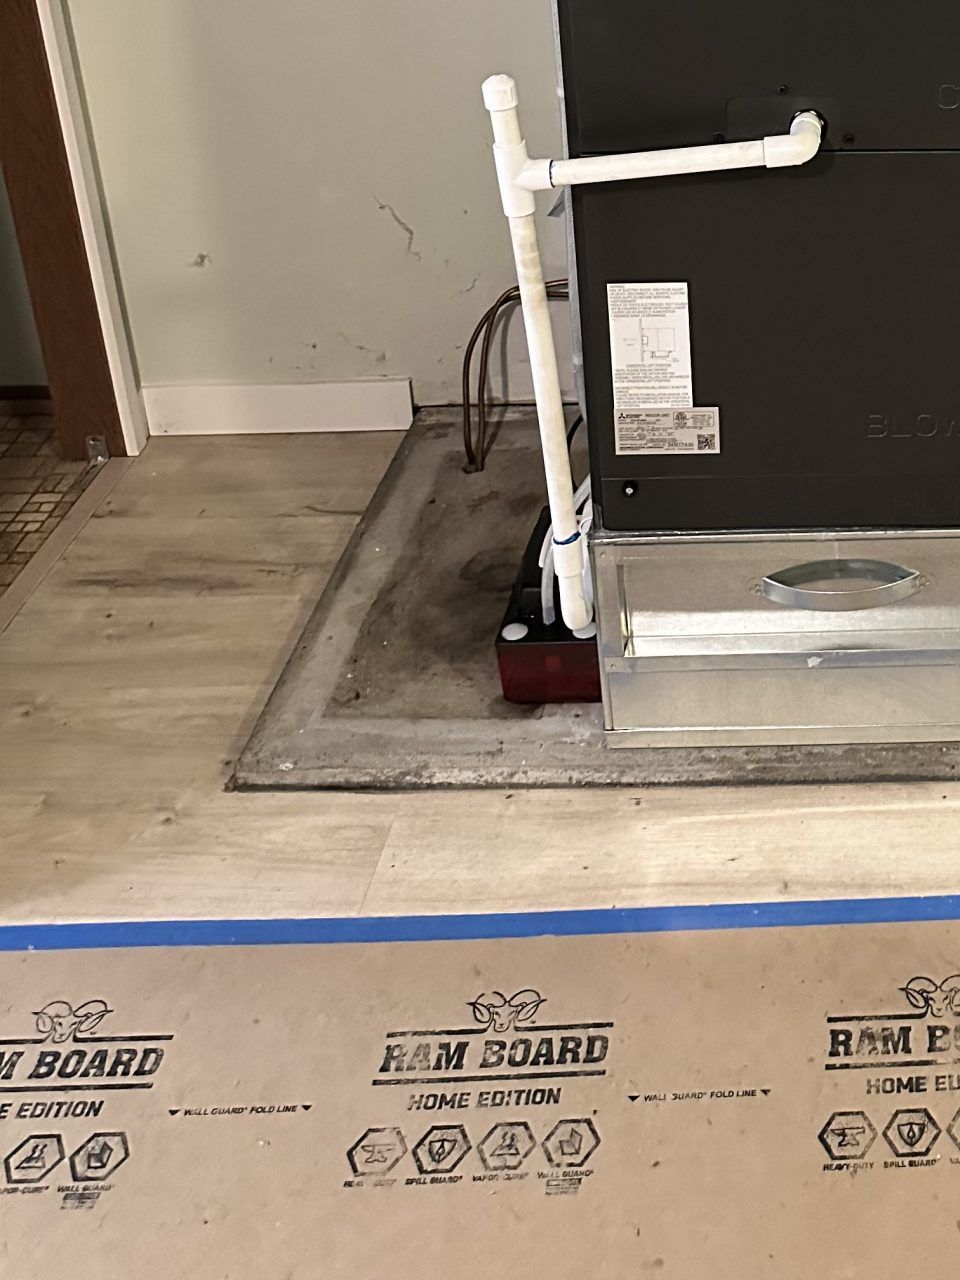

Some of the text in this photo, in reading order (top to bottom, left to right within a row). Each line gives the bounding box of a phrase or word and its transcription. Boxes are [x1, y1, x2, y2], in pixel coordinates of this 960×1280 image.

[828, 1025, 912, 1058] RAM
[28, 1047, 164, 1079] BOARD
[378, 1034, 610, 1073] RAM BOARD
[709, 1090, 735, 1099] FOLD
[736, 1089, 757, 1098] LINE
[866, 1076, 928, 1095] HOME
[407, 1087, 562, 1111] HOME EDITION
[15, 1100, 105, 1119] EDITION
[249, 1106, 275, 1115] FOLD
[276, 1104, 299, 1114] LINE
[822, 1162, 875, 1172] HEAVY-DUTY
[883, 1161, 907, 1169] SPILL
